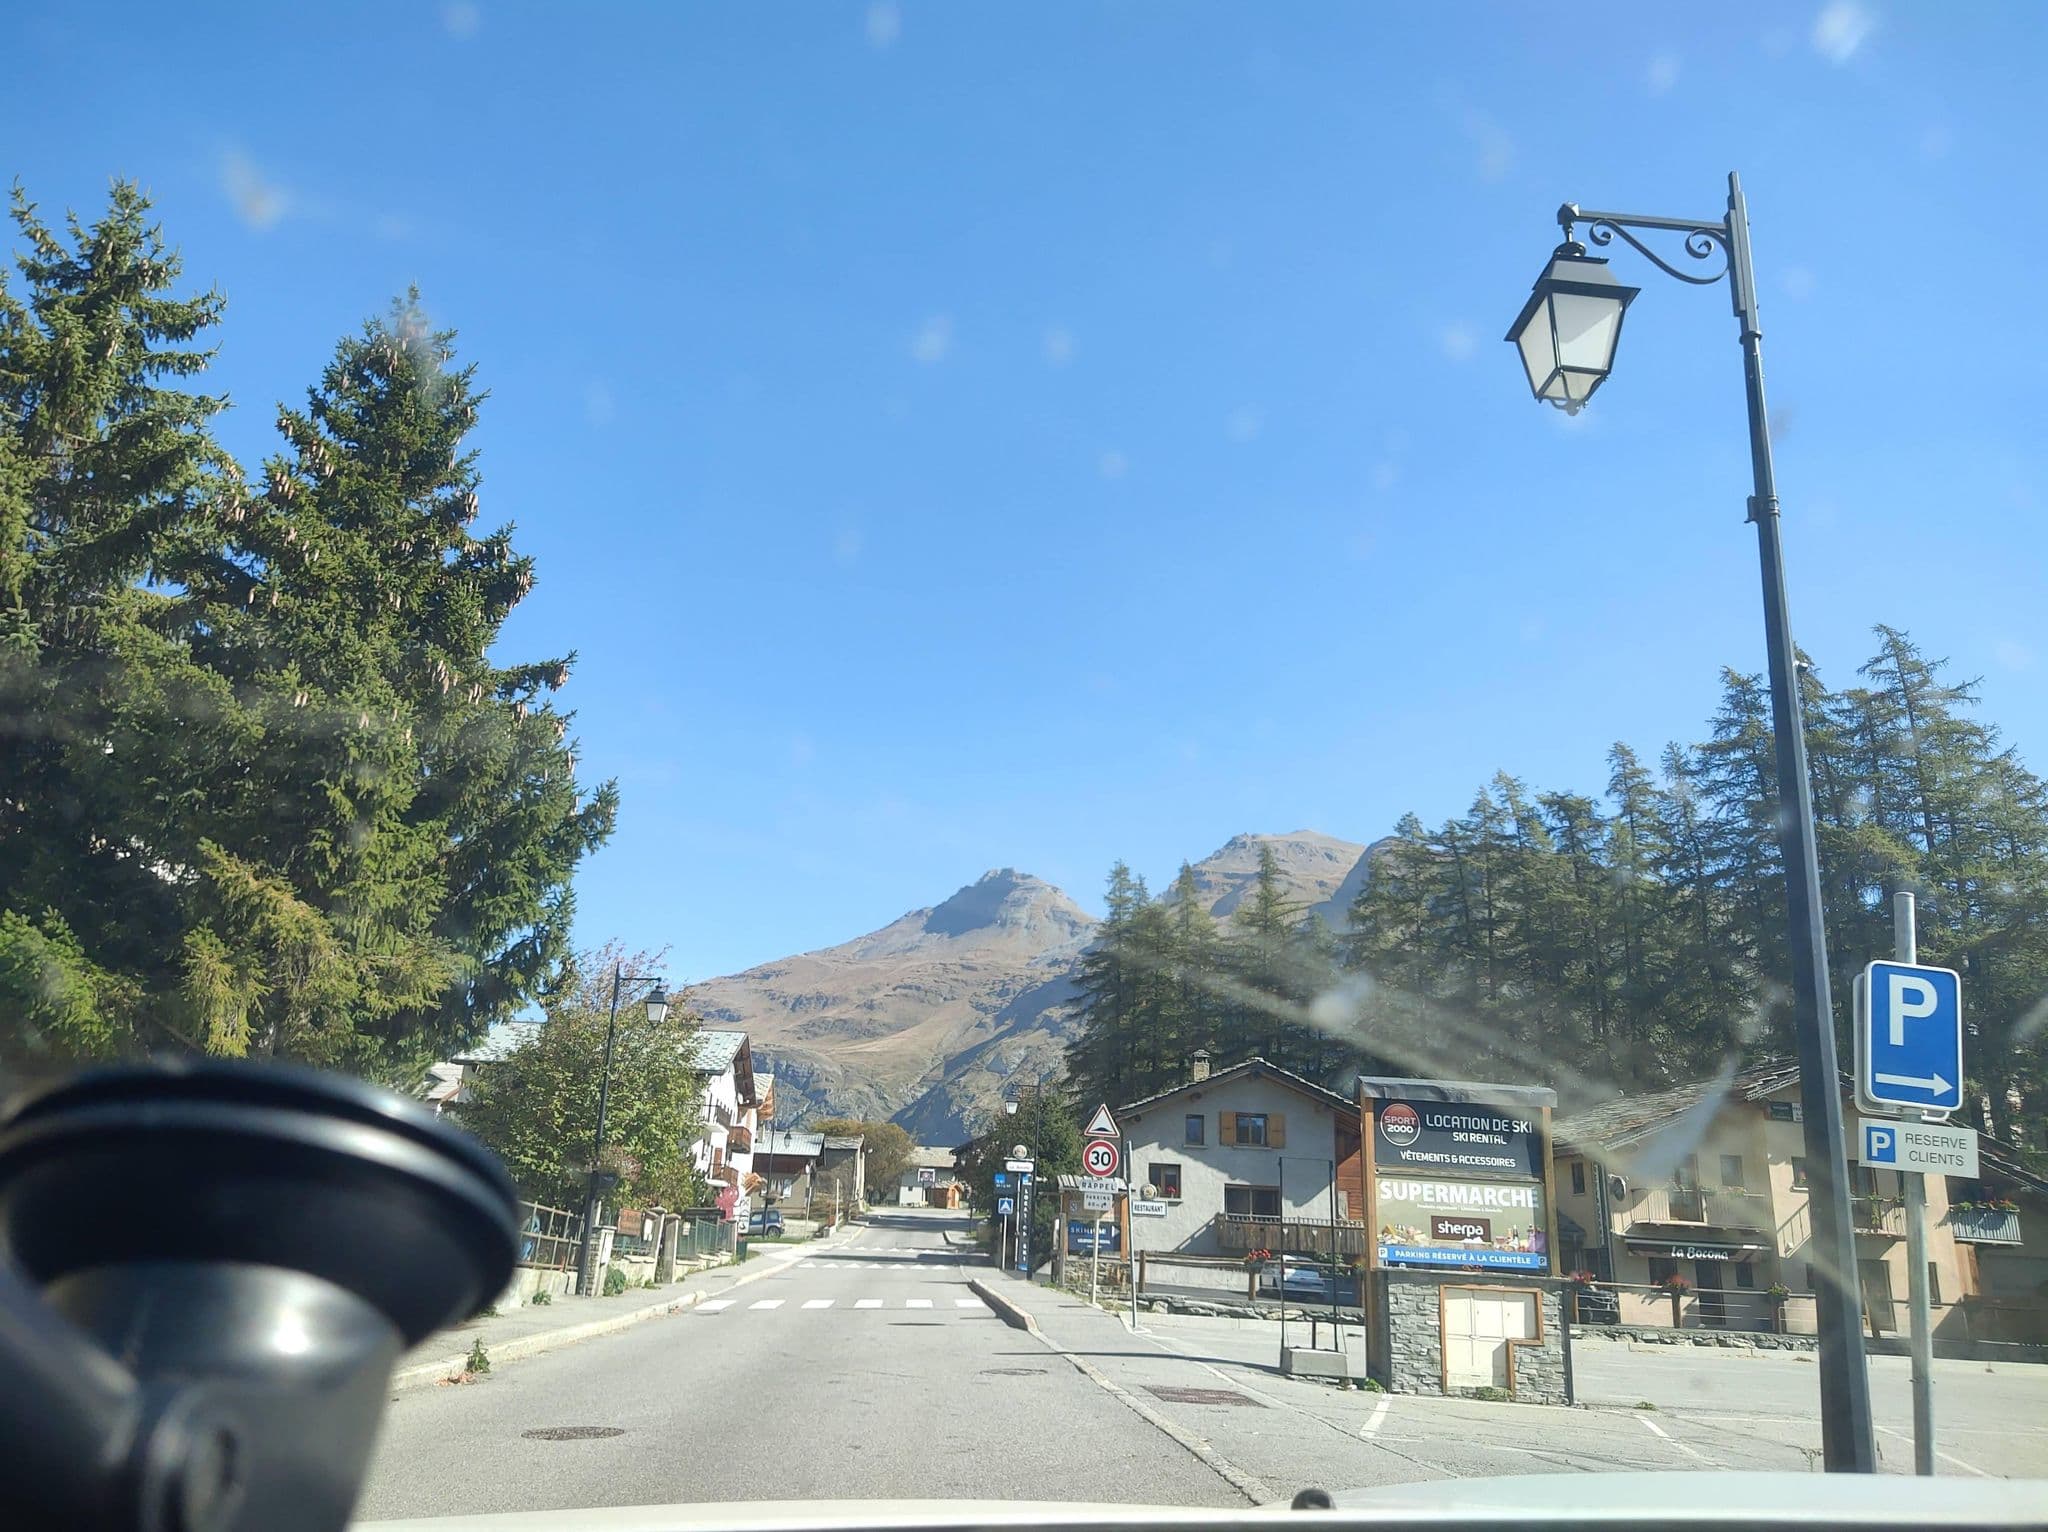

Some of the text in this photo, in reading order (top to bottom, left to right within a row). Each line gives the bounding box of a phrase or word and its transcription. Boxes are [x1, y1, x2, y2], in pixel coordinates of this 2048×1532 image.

[1889, 974, 1938, 1046] P
[1384, 1115, 1416, 1125] SPORT
[1426, 1114, 1532, 1133] LOCATION DE SKI
[1387, 1124, 1414, 1133] 2000
[1453, 1132, 1507, 1145] SKI RENTAL
[1871, 1131, 1967, 1157] P RESERVE
[1090, 1151, 1112, 1166] 30
[1400, 1150, 1516, 1168] VÊTEMENTS & ACCESSOIRES
[1909, 1150, 1965, 1166] CLIENTS
[1082, 1181, 1116, 1191] RAPPEL
[1134, 1203, 1164, 1213] RESTAURANT
[1437, 1220, 1484, 1237] sherpa
[1395, 1250, 1430, 1259] PARKING
[1432, 1250, 1466, 1261] RÉSERVÉ
[1469, 1252, 1475, 1261] À
[1489, 1254, 1531, 1265] CLIENTÈLE
[1671, 1246, 1685, 1258] La
